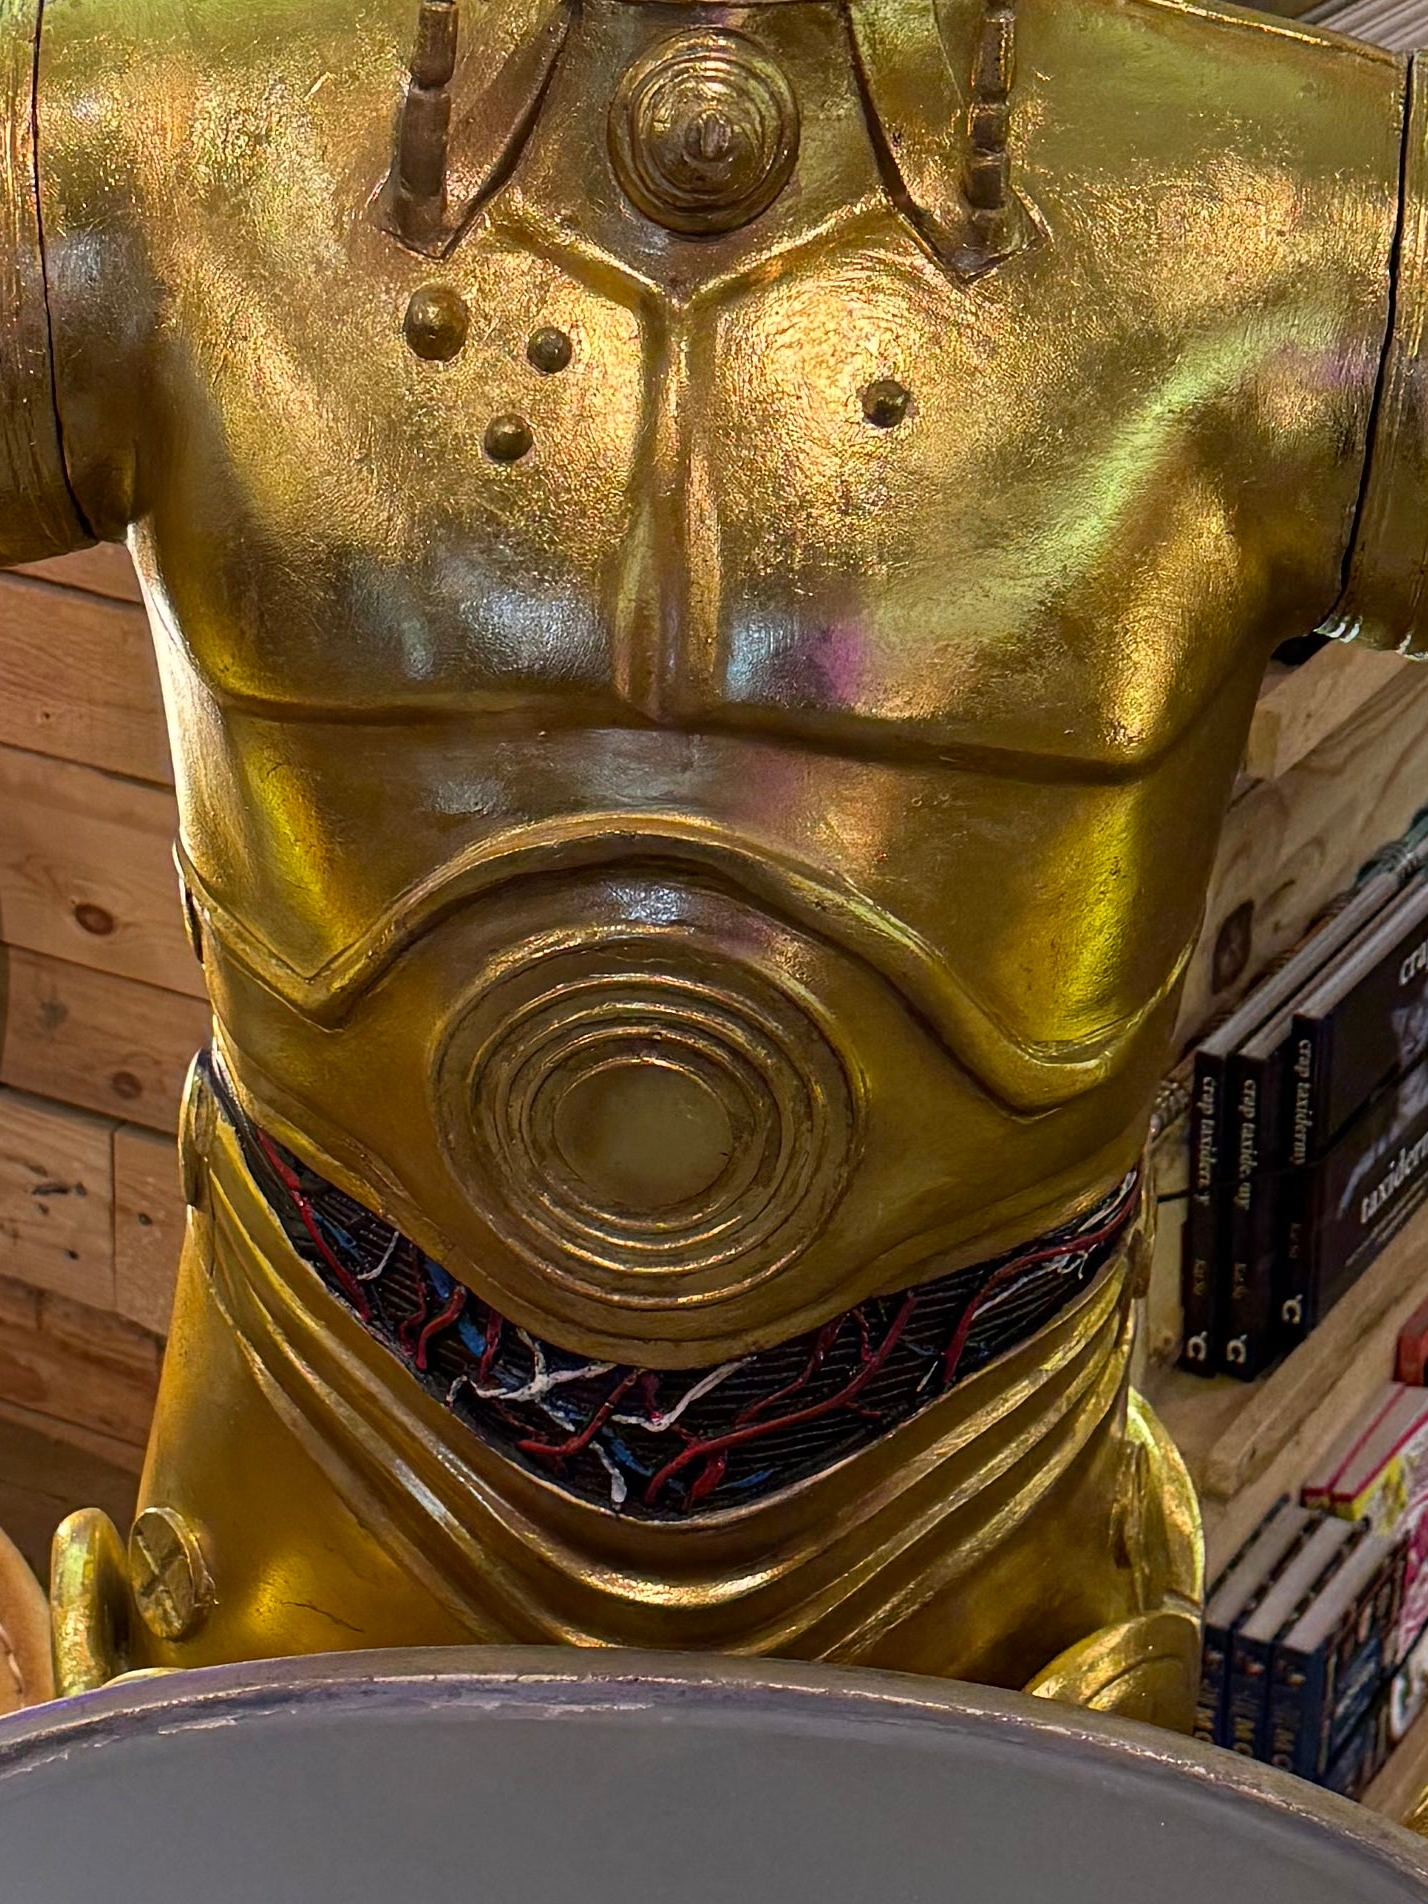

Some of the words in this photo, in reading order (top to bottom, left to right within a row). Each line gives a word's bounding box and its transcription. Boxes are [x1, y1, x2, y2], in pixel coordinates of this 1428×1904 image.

[1296, 1038, 1312, 1080] crap
[1196, 1075, 1217, 1118] crap
[1237, 1078, 1256, 1120] crap
[1289, 1079, 1314, 1167] taxidermy
